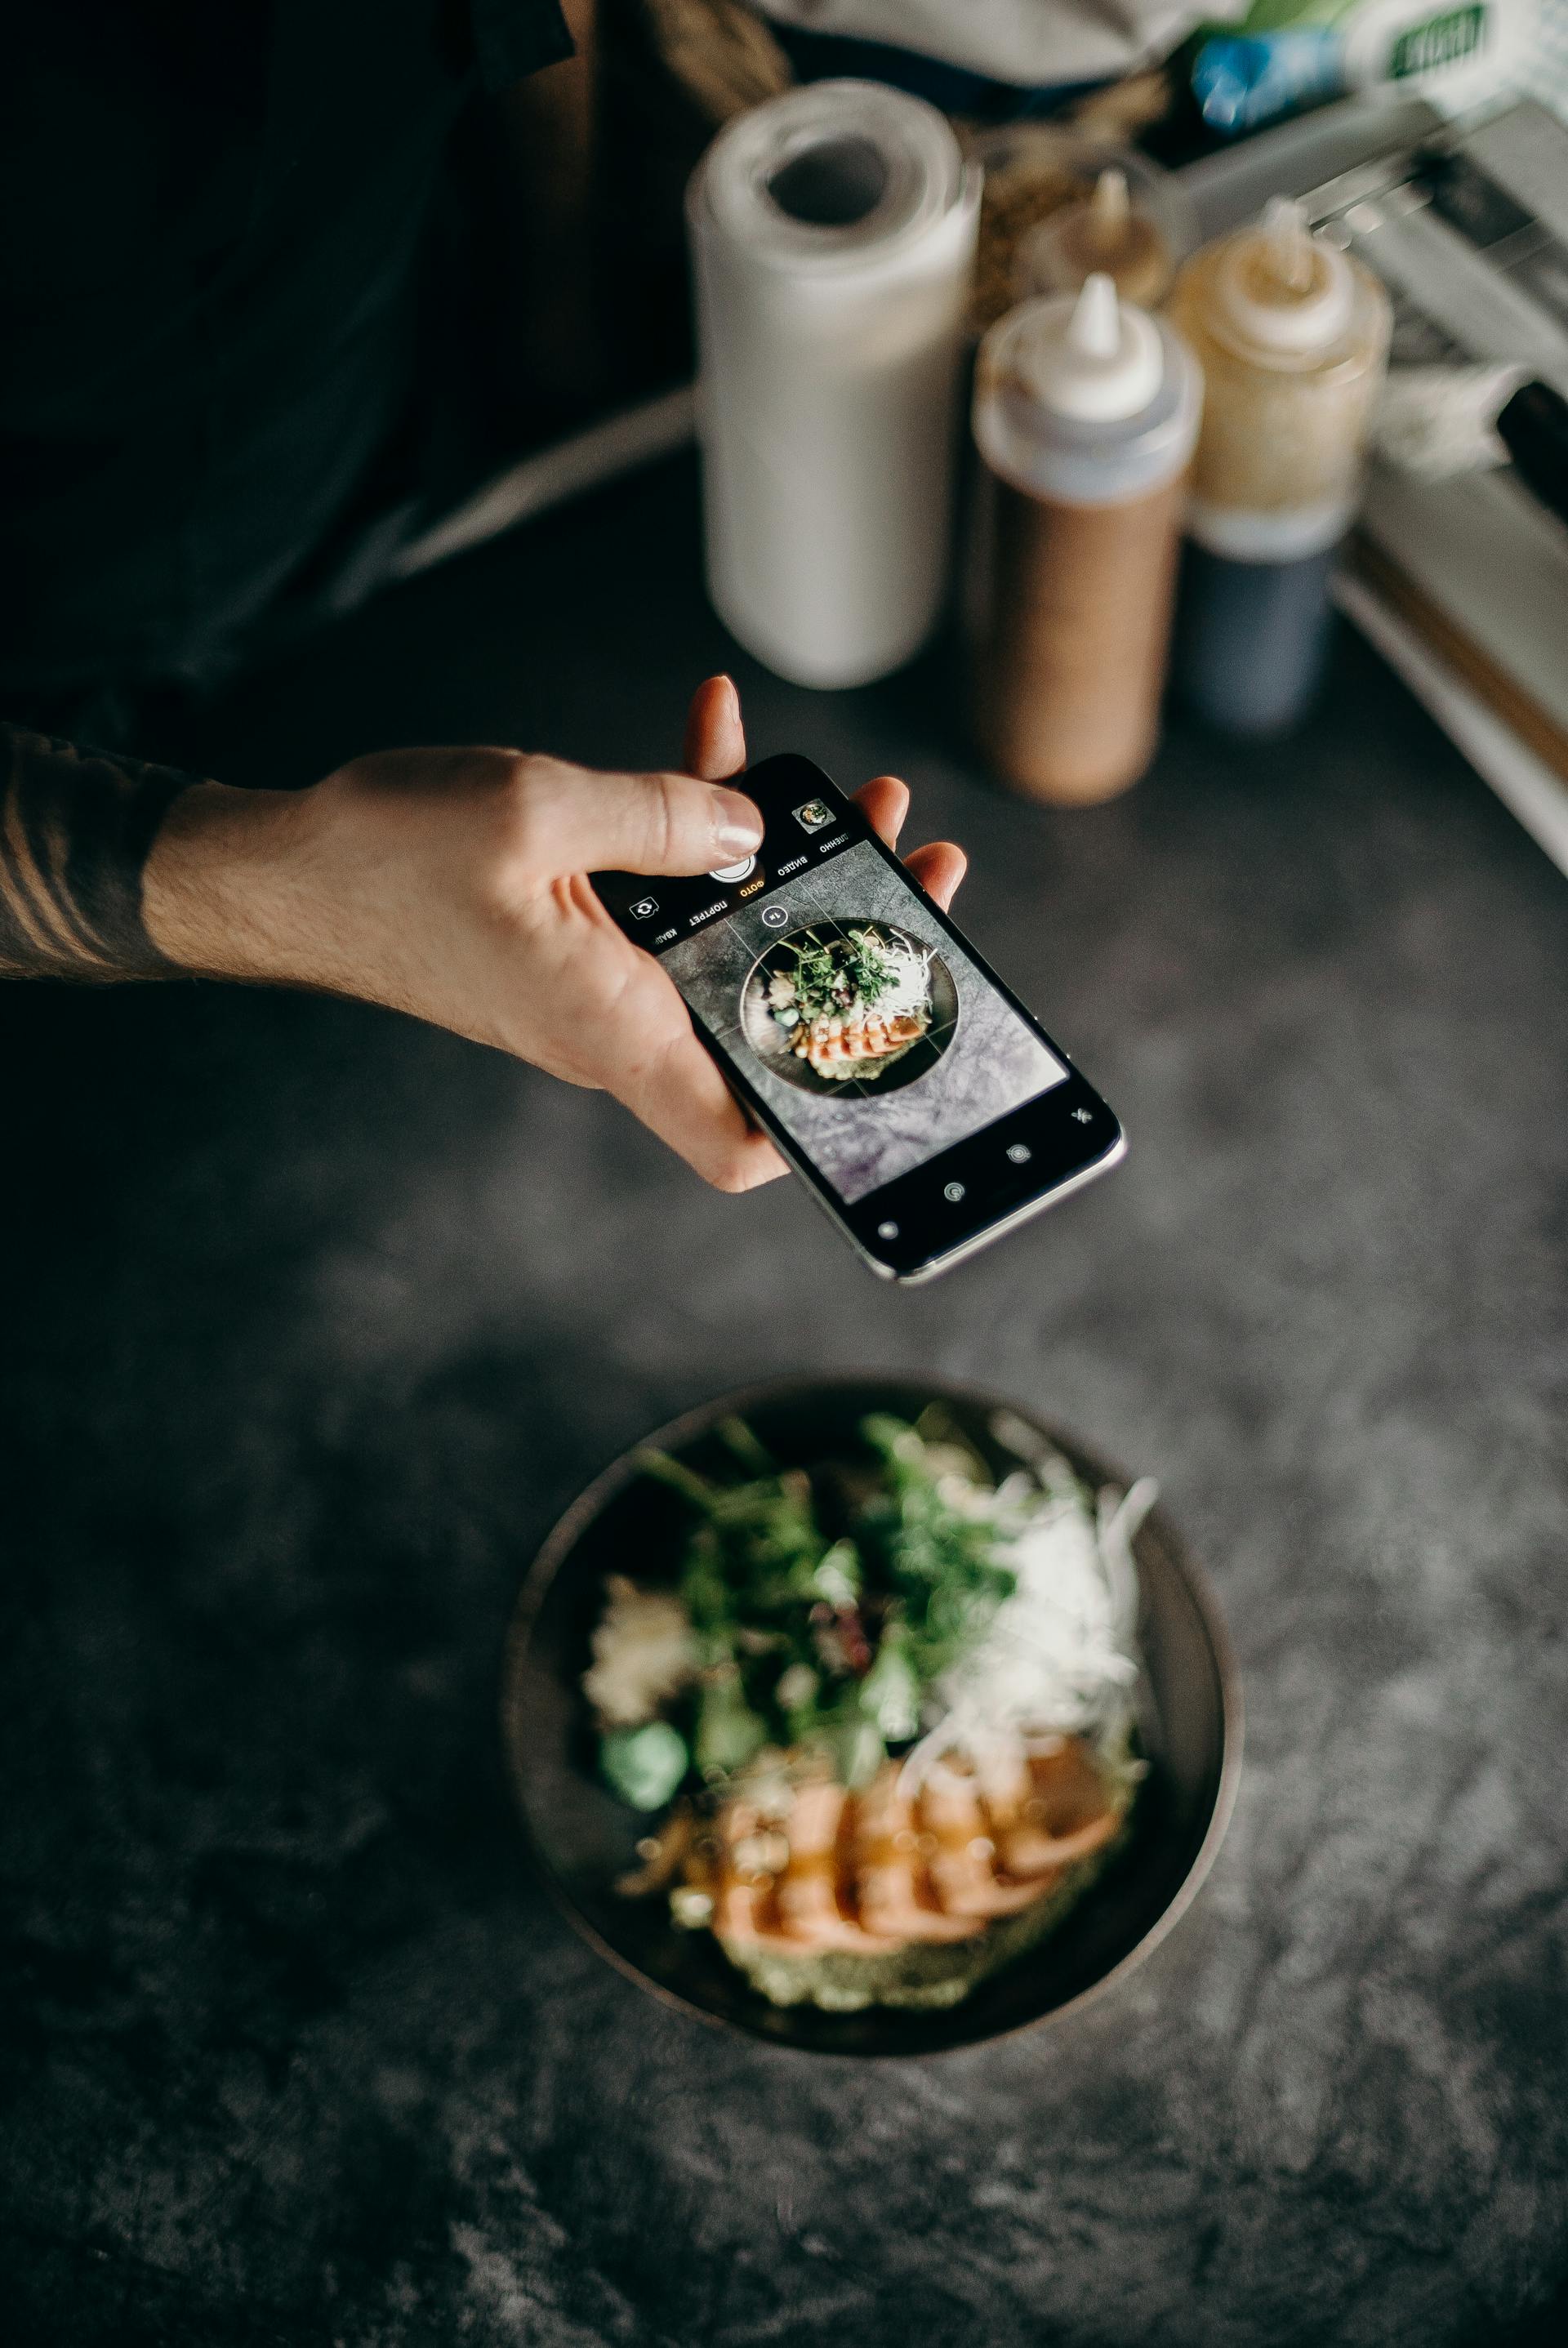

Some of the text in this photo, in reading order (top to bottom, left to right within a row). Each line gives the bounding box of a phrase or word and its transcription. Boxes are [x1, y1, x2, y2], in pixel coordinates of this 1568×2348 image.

[777, 856, 808, 876] ВИДЕО
[740, 879, 765, 898] ФОТО
[689, 900, 728, 927] ПОРТРЕТ
